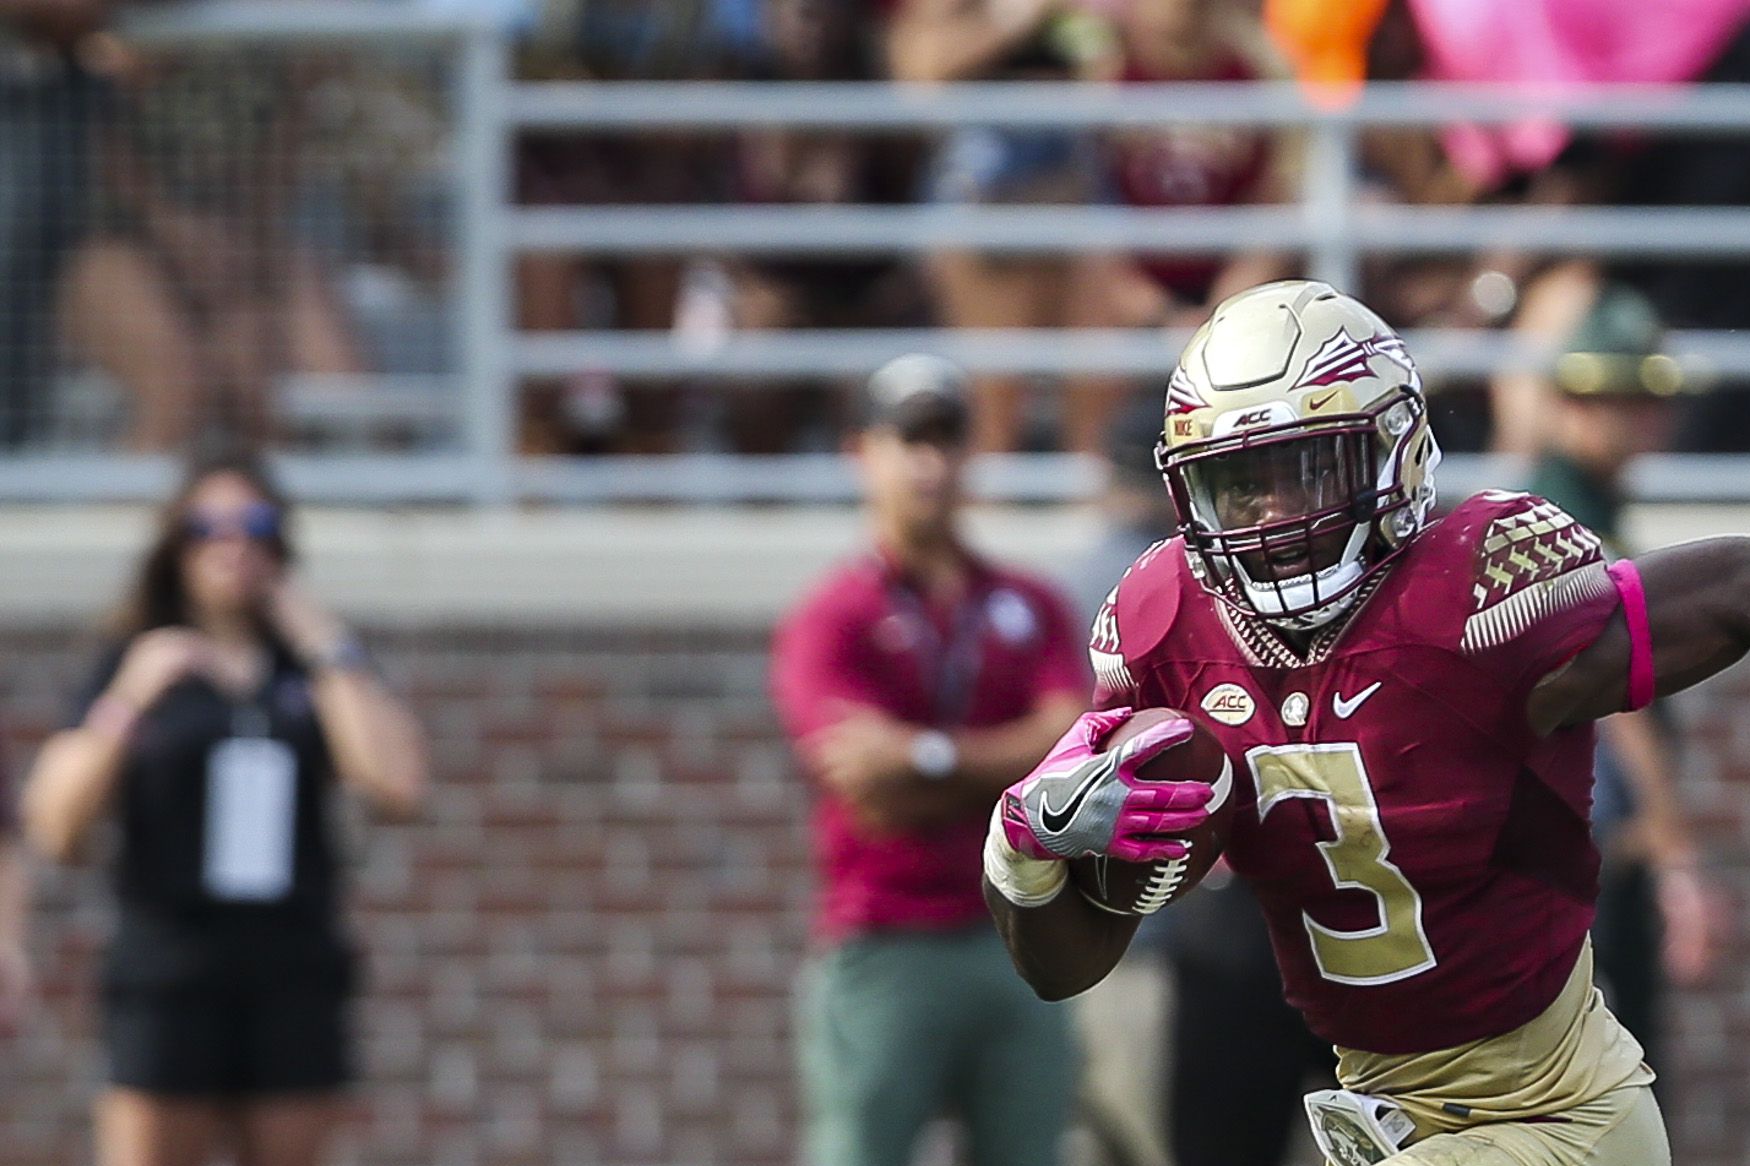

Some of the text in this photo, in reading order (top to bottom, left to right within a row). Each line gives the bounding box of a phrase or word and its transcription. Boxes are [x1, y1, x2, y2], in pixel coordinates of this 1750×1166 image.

[1233, 408, 1272, 427] ACC
[1212, 695, 1246, 709] ACC
[1245, 742, 1438, 986] 3
